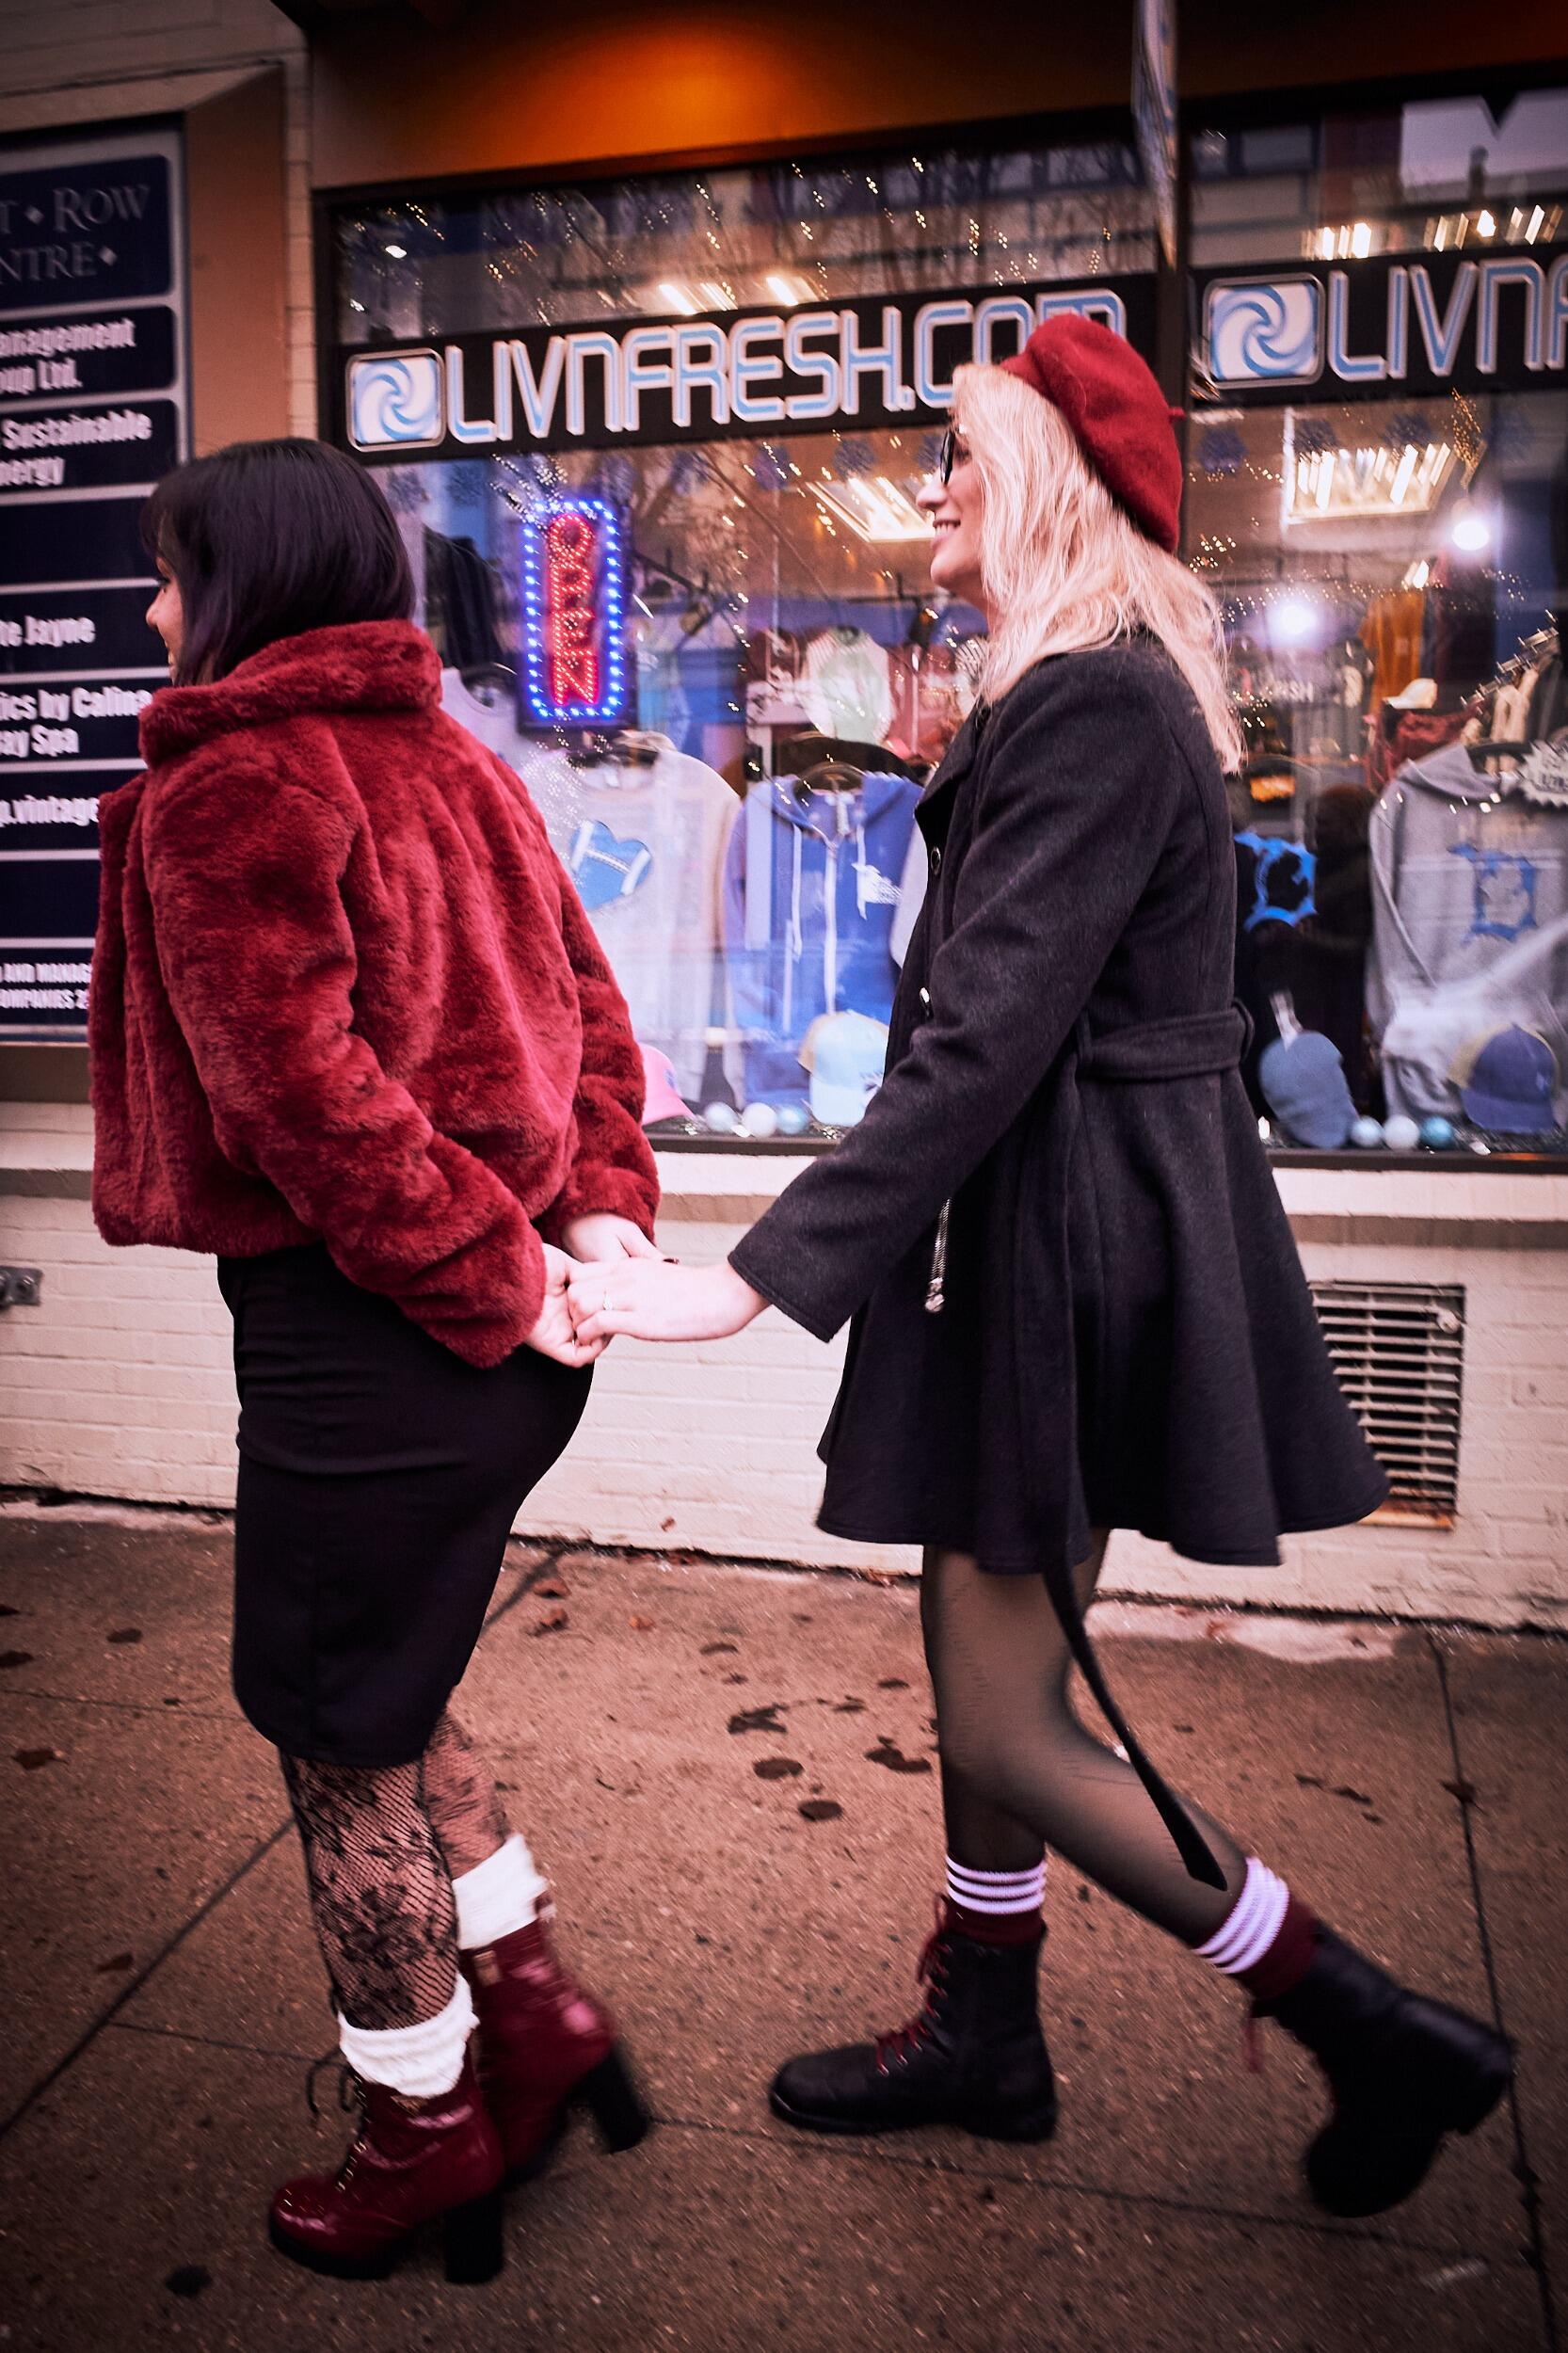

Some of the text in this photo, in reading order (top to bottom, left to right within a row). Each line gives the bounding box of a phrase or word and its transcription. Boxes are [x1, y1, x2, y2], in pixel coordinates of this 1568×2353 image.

[53, 184, 151, 233] ROW
[3, 408, 152, 450] Sustainable
[549, 512, 600, 706] OPEN
[39, 689, 70, 722] by
[30, 724, 79, 757] Spa
